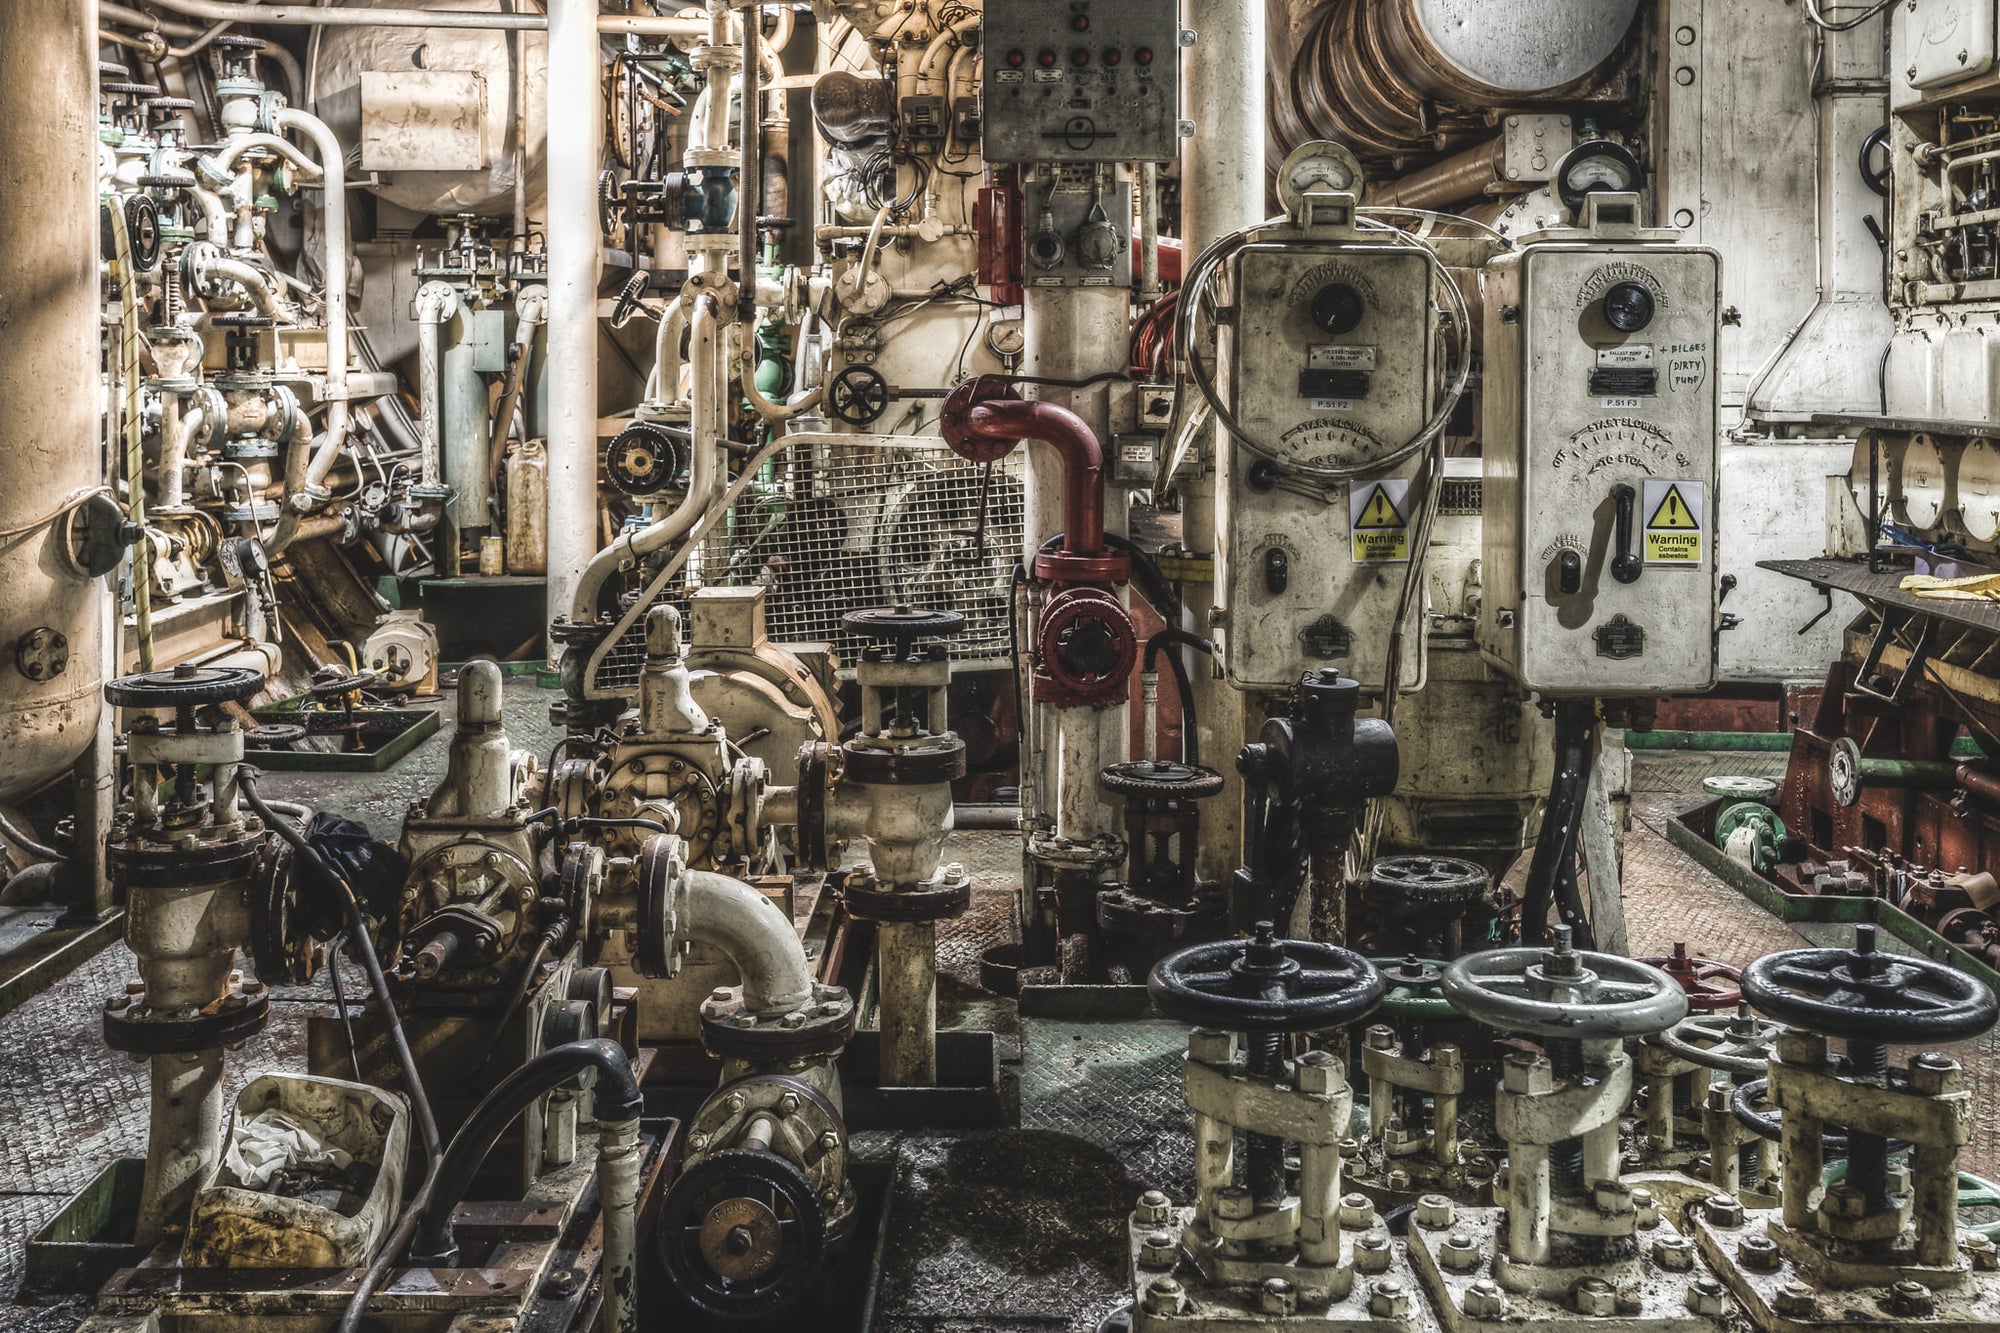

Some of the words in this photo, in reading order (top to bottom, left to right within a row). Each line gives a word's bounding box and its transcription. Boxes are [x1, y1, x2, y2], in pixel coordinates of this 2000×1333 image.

[1671, 343, 1706, 354] BILGES
[1627, 399, 1638, 407] F3
[1297, 418, 1329, 432] START
[1331, 418, 1368, 436] SLOWLY
[1586, 418, 1620, 432] START
[1621, 417, 1659, 435] SLOWLY
[1552, 449, 1567, 468] OFF
[1600, 455, 1614, 466] TO
[1618, 454, 1643, 467] STOP
[1675, 451, 1690, 468] ON
[1356, 534, 1405, 545] Warning
[1648, 534, 1697, 547] Warning
